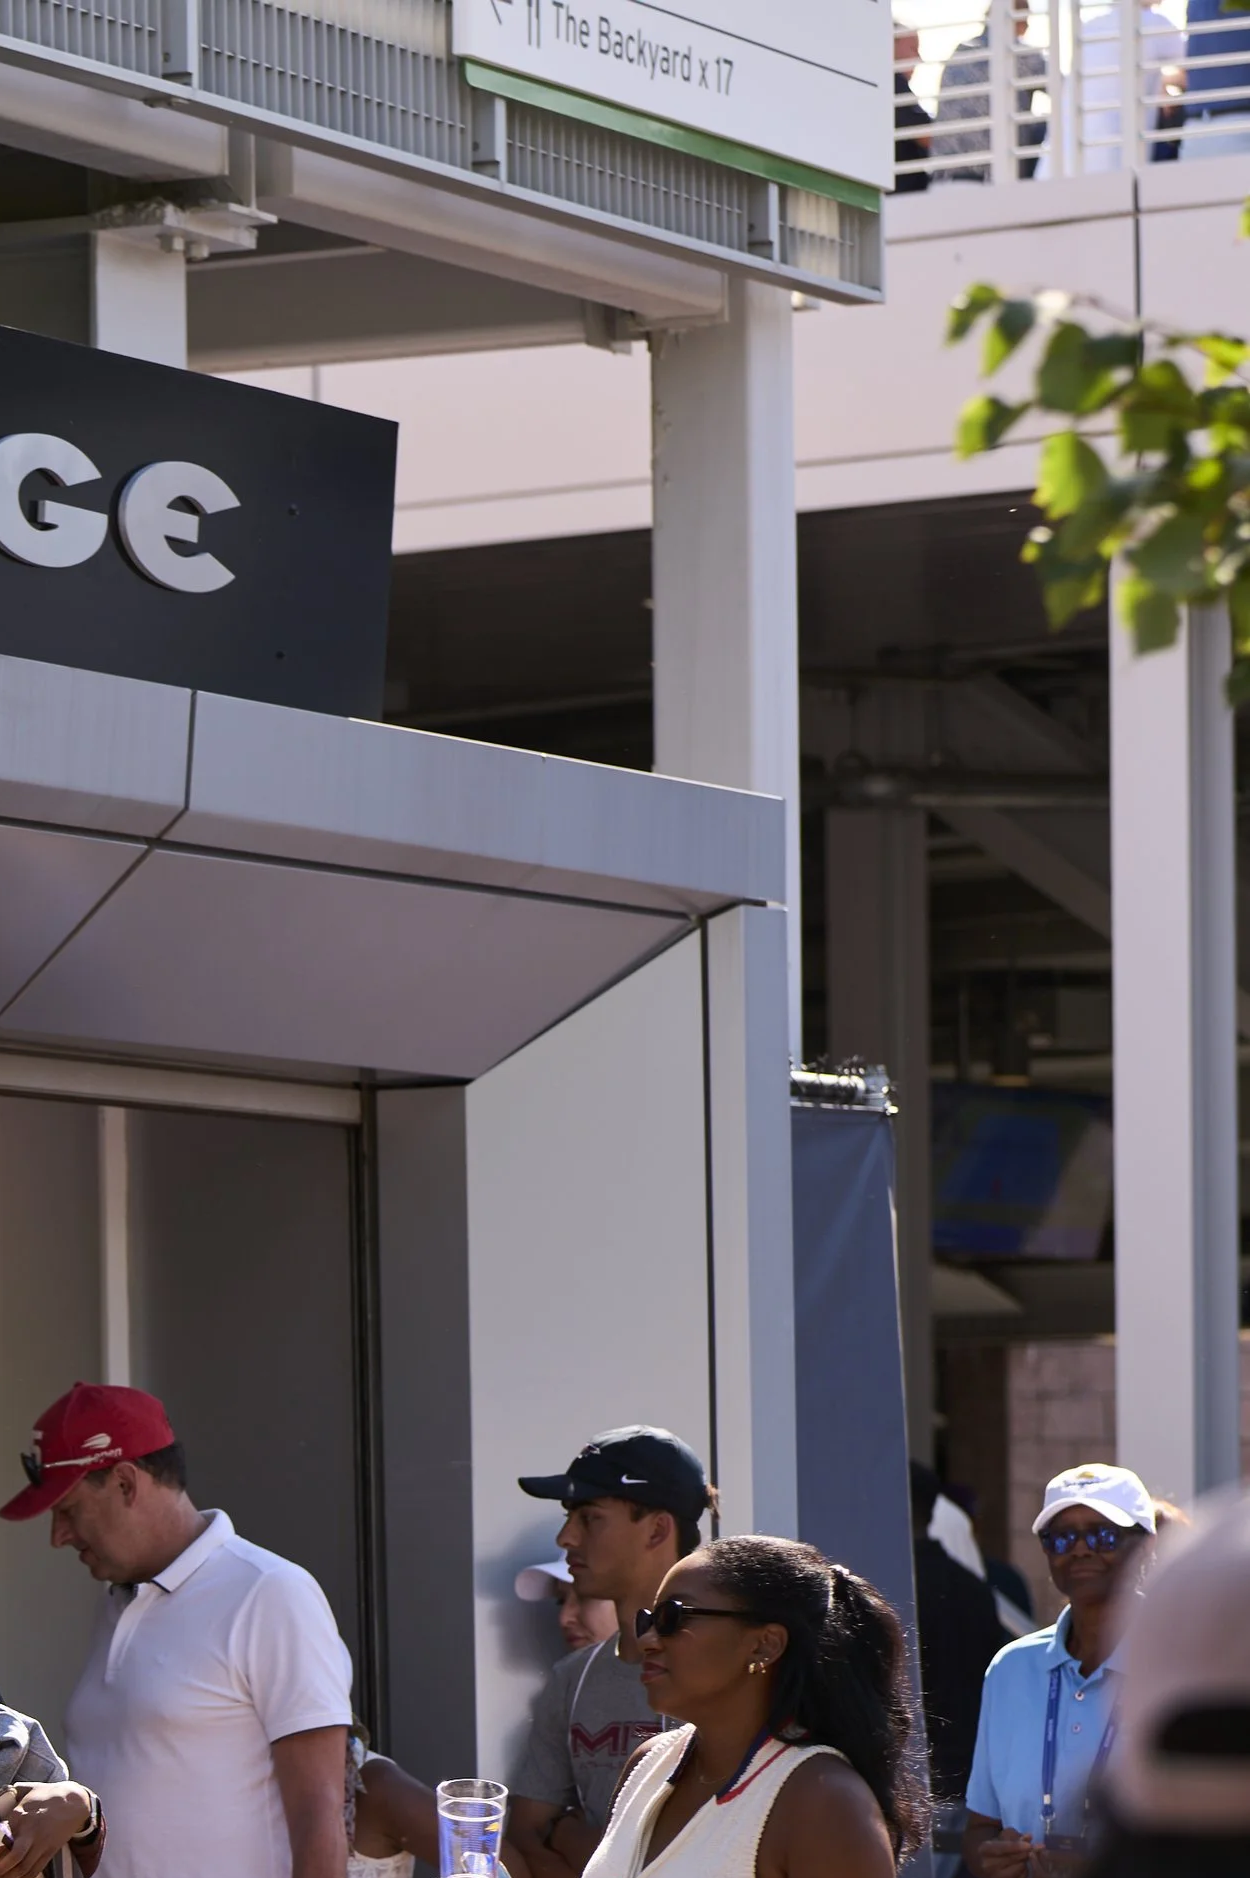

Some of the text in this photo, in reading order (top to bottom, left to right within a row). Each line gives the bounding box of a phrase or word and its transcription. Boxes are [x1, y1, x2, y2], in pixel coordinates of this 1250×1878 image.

[552, 1, 734, 96] The Backyard x 17
